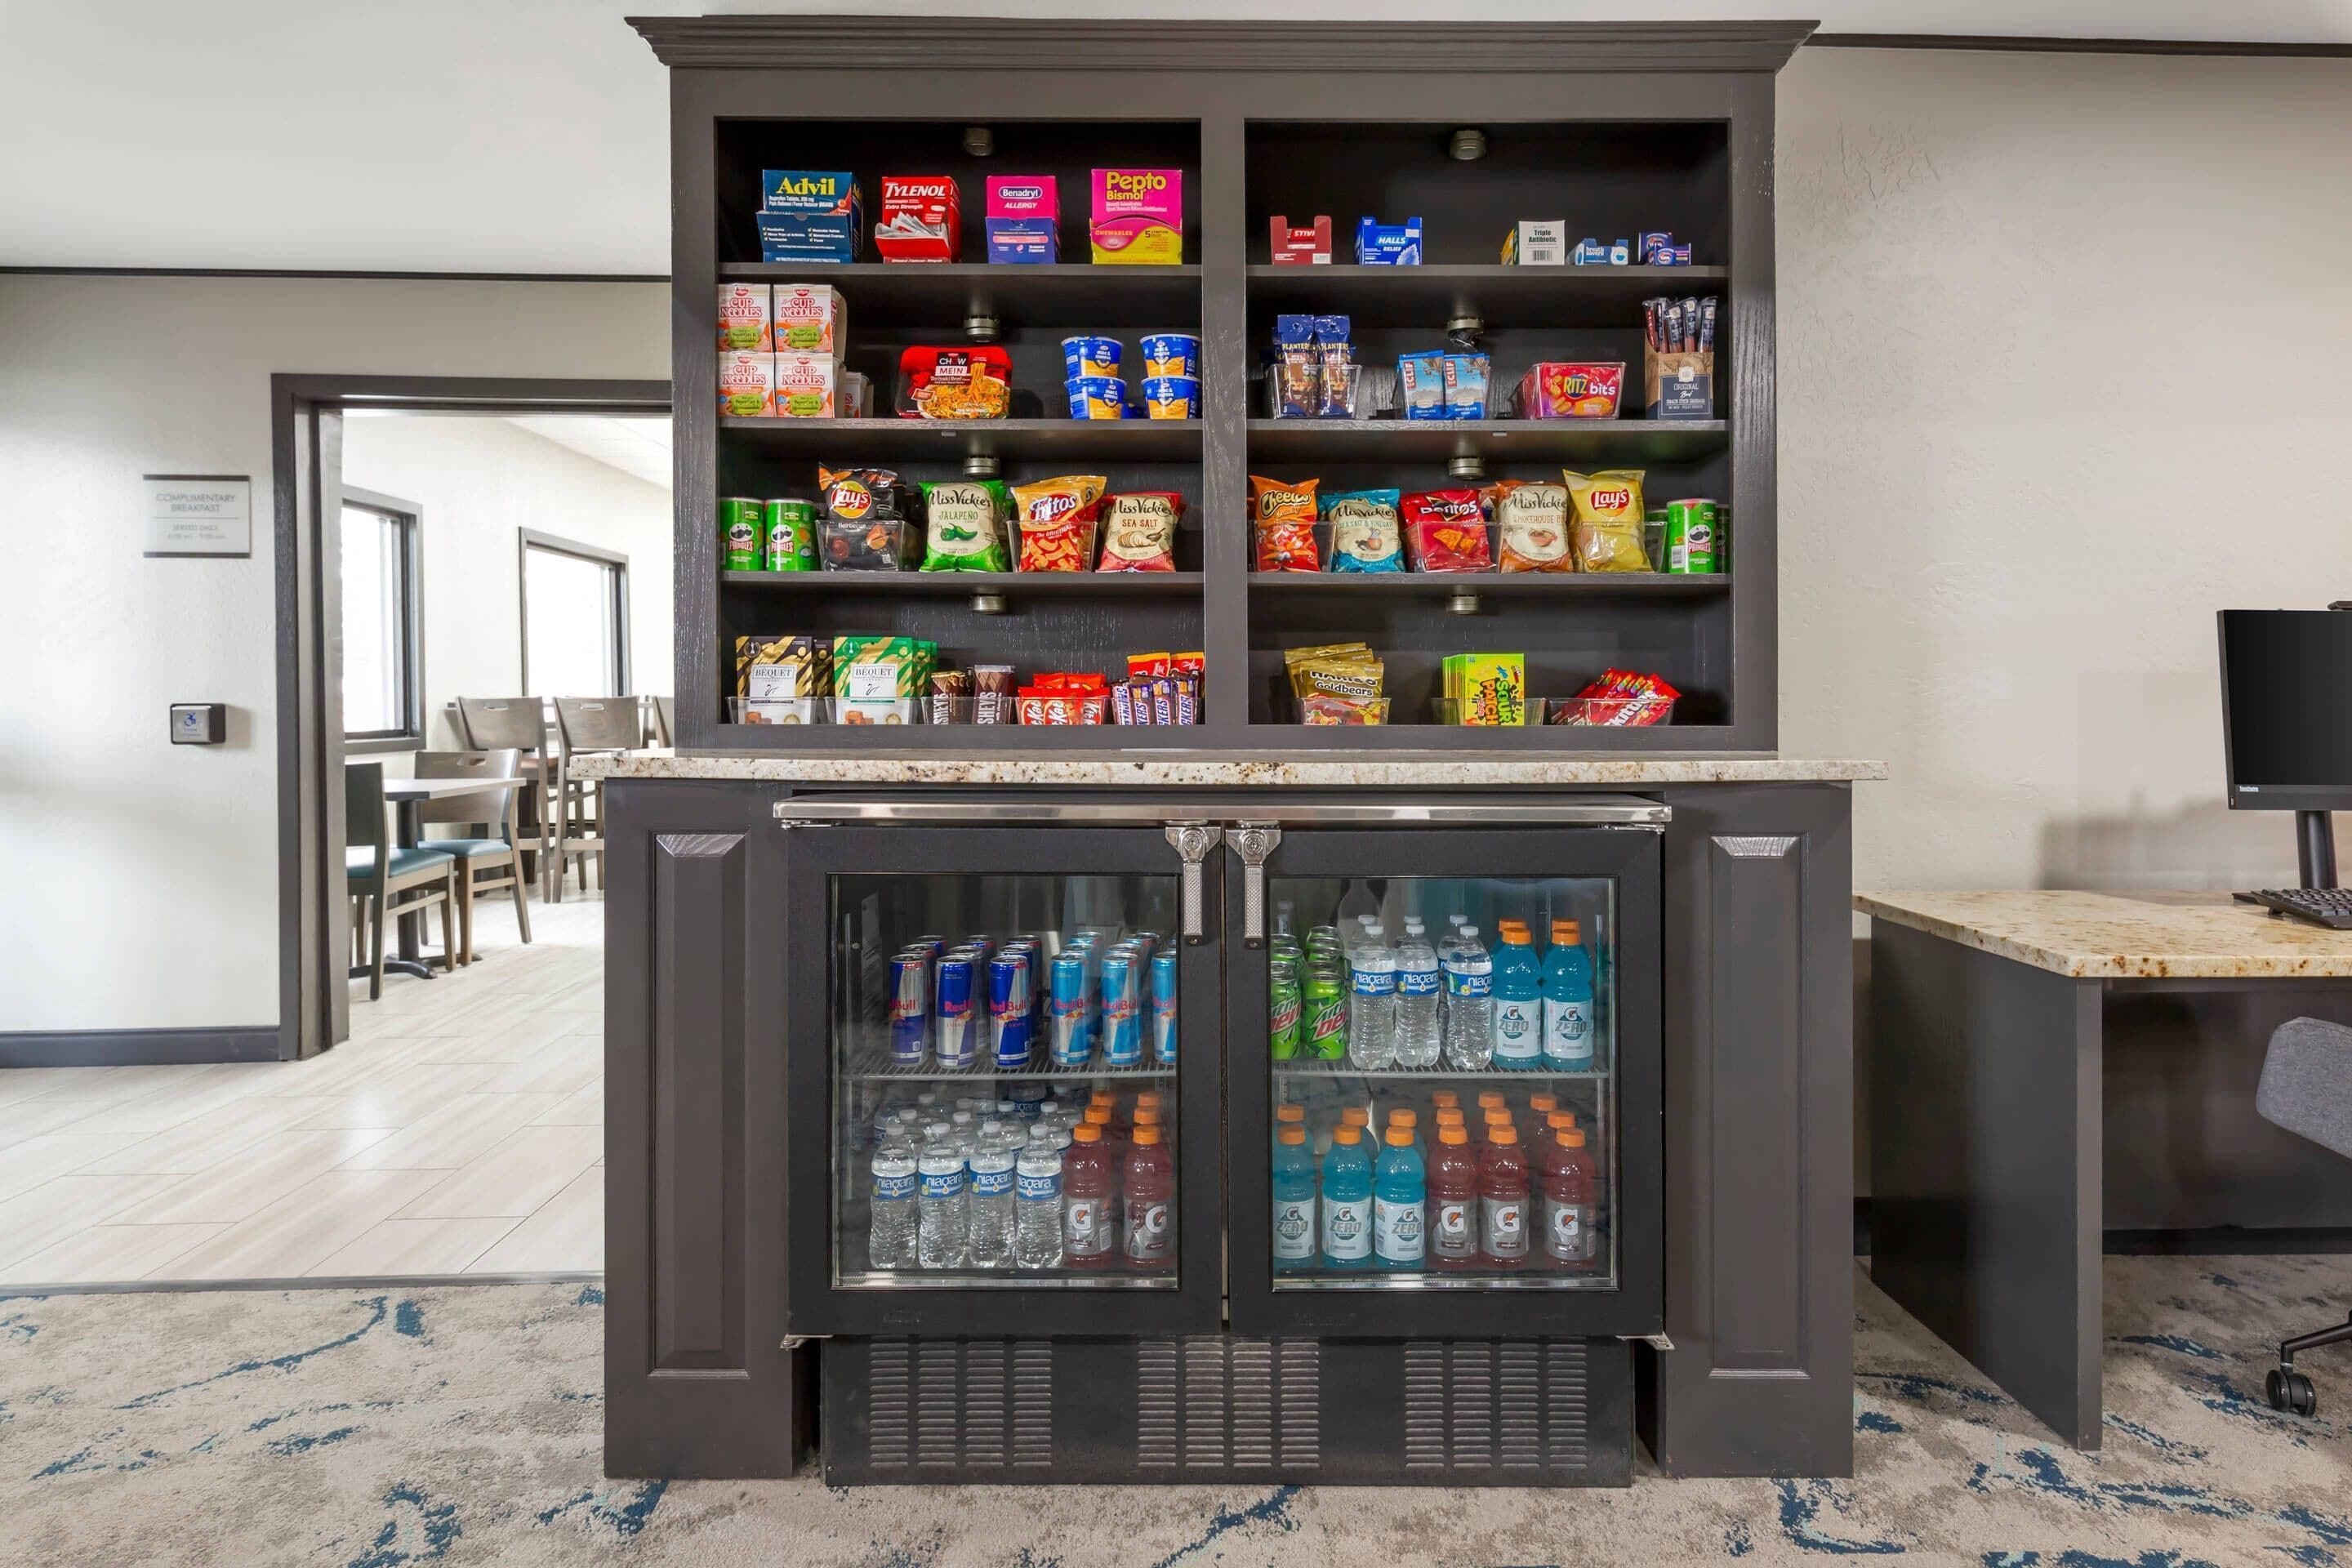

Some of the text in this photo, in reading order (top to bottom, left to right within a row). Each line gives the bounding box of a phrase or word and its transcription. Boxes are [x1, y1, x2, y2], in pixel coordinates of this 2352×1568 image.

[776, 176, 835, 195] Advil
[1107, 172, 1166, 192] Pepto
[885, 183, 947, 198] TYLENOL
[1003, 189, 1038, 198] Benadryl
[1107, 190, 1145, 200] Bismol
[730, 298, 754, 308] CUP
[790, 298, 815, 309] CUP
[720, 307, 763, 318] NOODLES
[782, 307, 823, 318] NOODLES
[733, 365, 758, 375] CUP
[791, 366, 817, 376] CUP
[939, 367, 964, 375] MEIN
[1405, 363, 1414, 381] CLIF
[1446, 361, 1455, 380] CLIF
[723, 374, 766, 385] NOODLES
[782, 375, 825, 385] NOODLES
[1564, 376, 1616, 395] RITZ bits
[1680, 390, 1693, 399] Beef
[156, 493, 236, 503] COMPLIMENTARY
[834, 488, 869, 510] Lay's
[930, 488, 992, 510] Miss Vickie's
[1260, 490, 1311, 518] Cheetos
[1508, 490, 1566, 512] Miss Vickie
[1594, 490, 1628, 510] Lay's
[171, 503, 220, 512] BREAKFAST
[1028, 495, 1076, 522] Fritos
[1420, 500, 1477, 515] Doritos
[938, 510, 979, 521] JALAPEÑO
[1513, 515, 1552, 524] SMOKEHOUSE
[838, 522, 866, 530] Barbecue
[1045, 523, 1075, 537] ORIGINAL
[1122, 519, 1158, 528] SEA SALT
[728, 541, 754, 552] PRINGLES
[1687, 542, 1712, 555] PRINGLES
[1316, 681, 1374, 697] Goldbears
[1496, 679, 1512, 723] SOUR
[1136, 703, 1147, 724] KERS
[1179, 695, 1192, 724] CKERS
[1355, 973, 1392, 986] niagara
[1403, 973, 1439, 986] niagara
[1468, 975, 1492, 987] niaga
[898, 999, 915, 1010] Bull
[944, 999, 968, 1013] Red
[1006, 999, 1026, 1011] Bull
[1054, 999, 1076, 1009] Red
[1498, 1019, 1530, 1032] ZERO
[1555, 1020, 1588, 1033] ZERO
[876, 1176, 915, 1190] niagara
[926, 1172, 963, 1187] niagara
[977, 1171, 1013, 1187] niagara
[1069, 1203, 1091, 1231] G
[1145, 1204, 1167, 1234] G
[1441, 1205, 1464, 1233] G
[1495, 1205, 1520, 1233] G
[1554, 1208, 1579, 1236] G
[1276, 1220, 1308, 1234] ZERO
[1330, 1222, 1361, 1234] ZERO
[1392, 1222, 1421, 1234] ZERO
